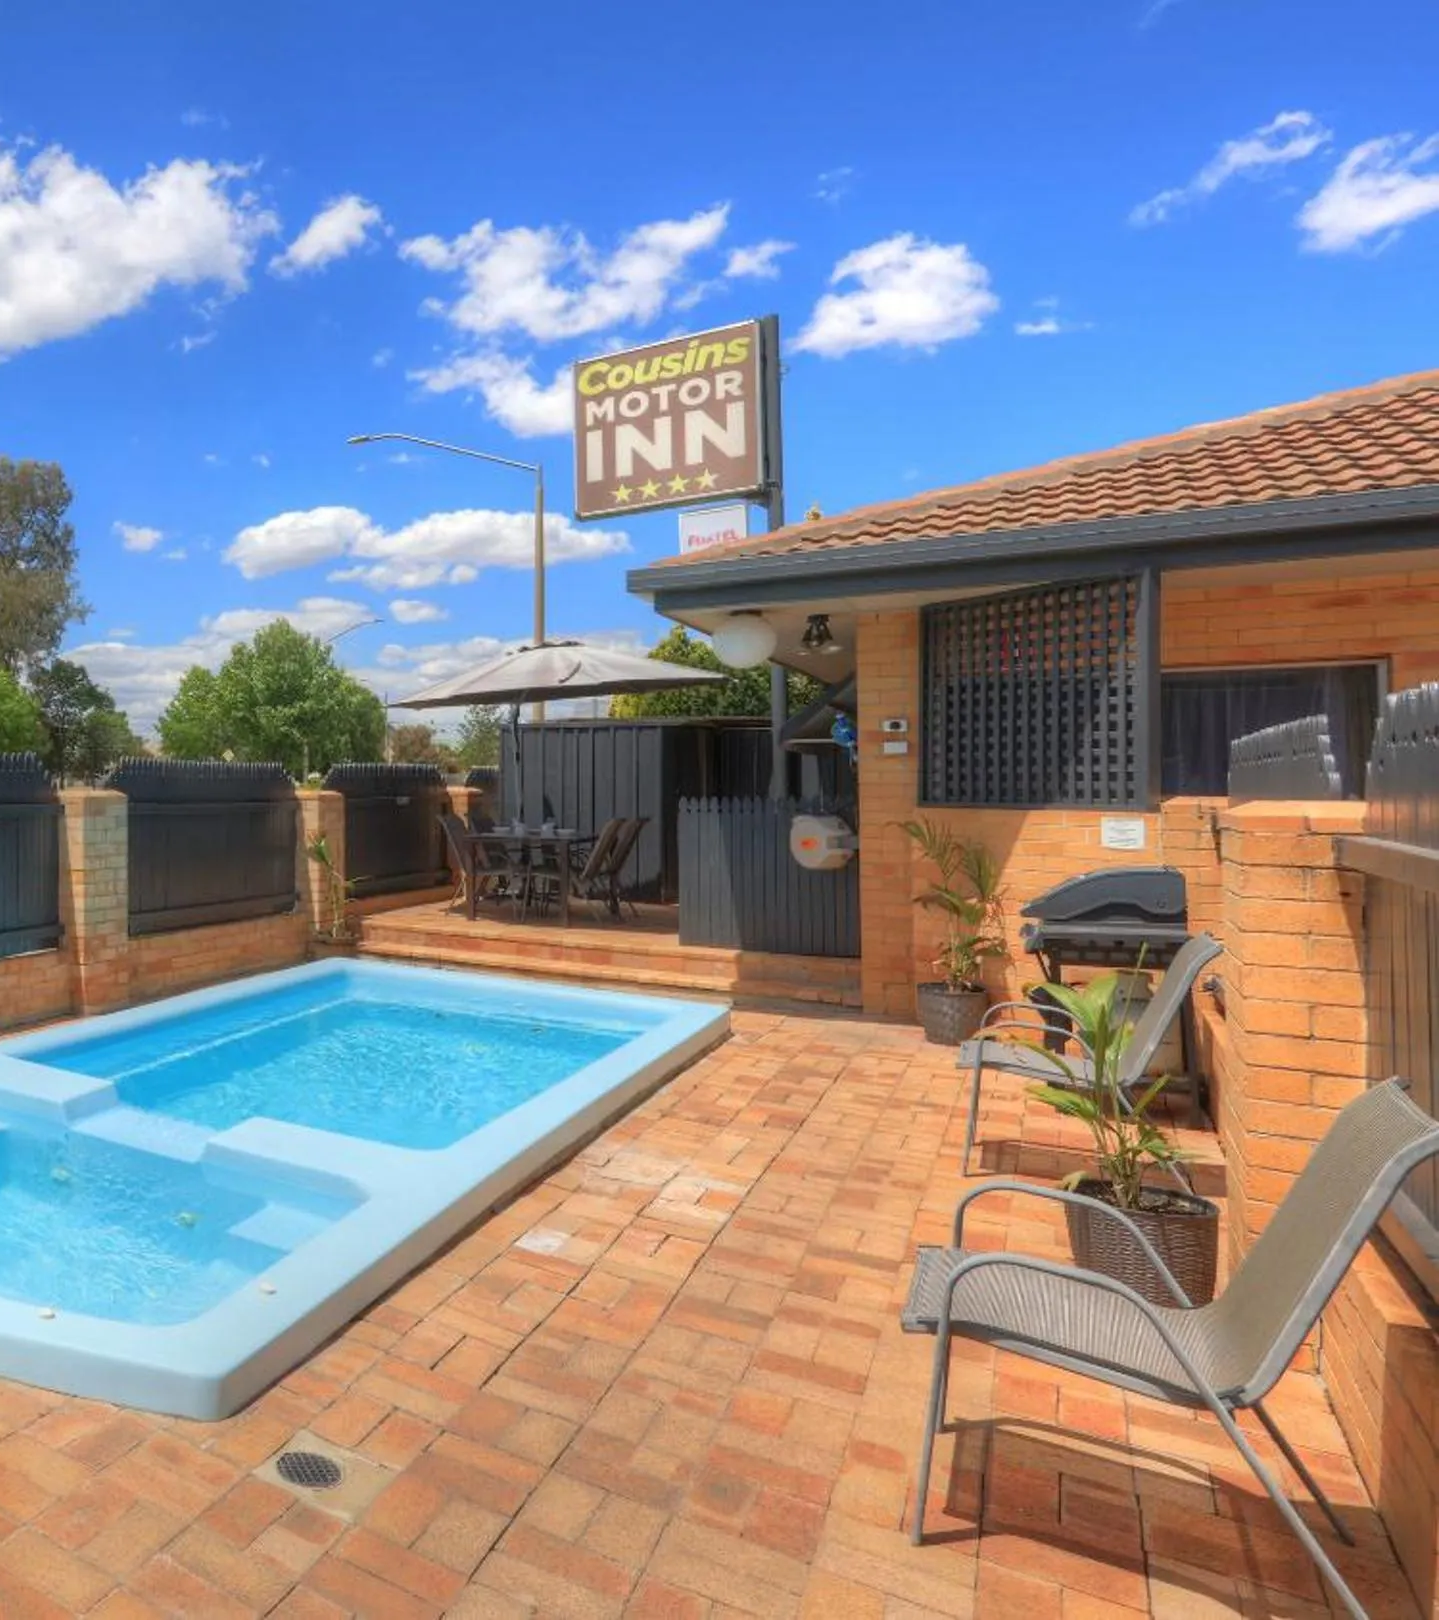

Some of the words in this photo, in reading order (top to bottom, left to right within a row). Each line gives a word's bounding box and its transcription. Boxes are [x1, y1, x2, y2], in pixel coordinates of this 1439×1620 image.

[578, 337, 752, 396] Cousins
[585, 370, 744, 427] MOTOR
[586, 400, 747, 483] INN
